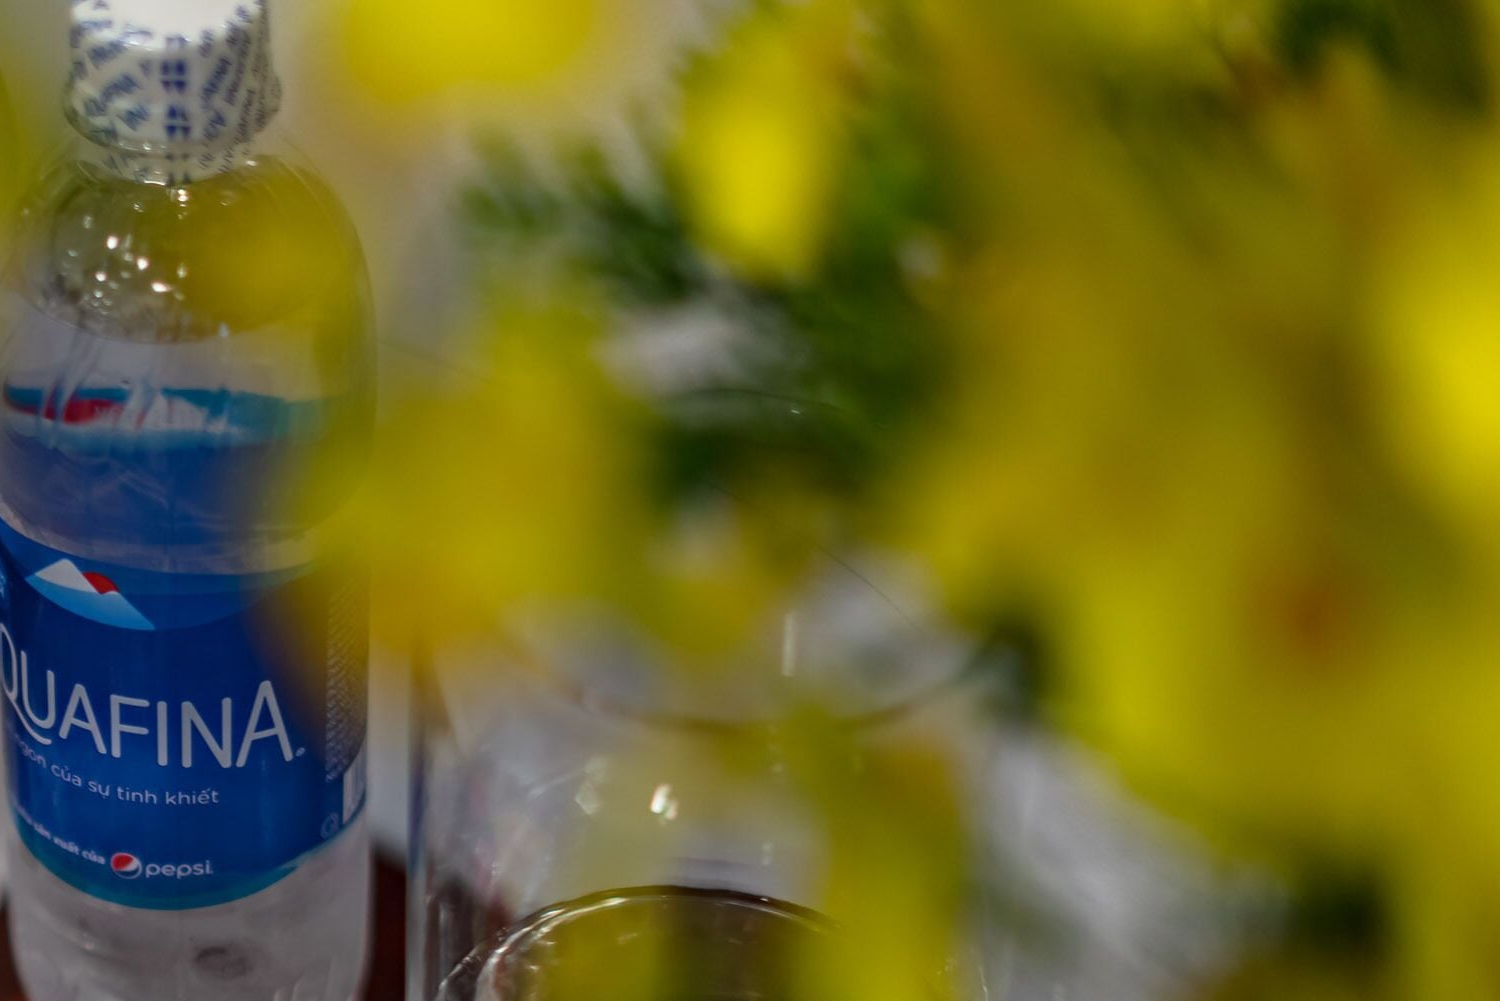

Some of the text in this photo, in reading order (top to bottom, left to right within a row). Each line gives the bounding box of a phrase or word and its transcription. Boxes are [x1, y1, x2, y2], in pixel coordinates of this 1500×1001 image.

[51, 763, 82, 787] của
[116, 786, 158, 805] tinh
[165, 787, 220, 806] khiết
[145, 859, 213, 880] pepsi
